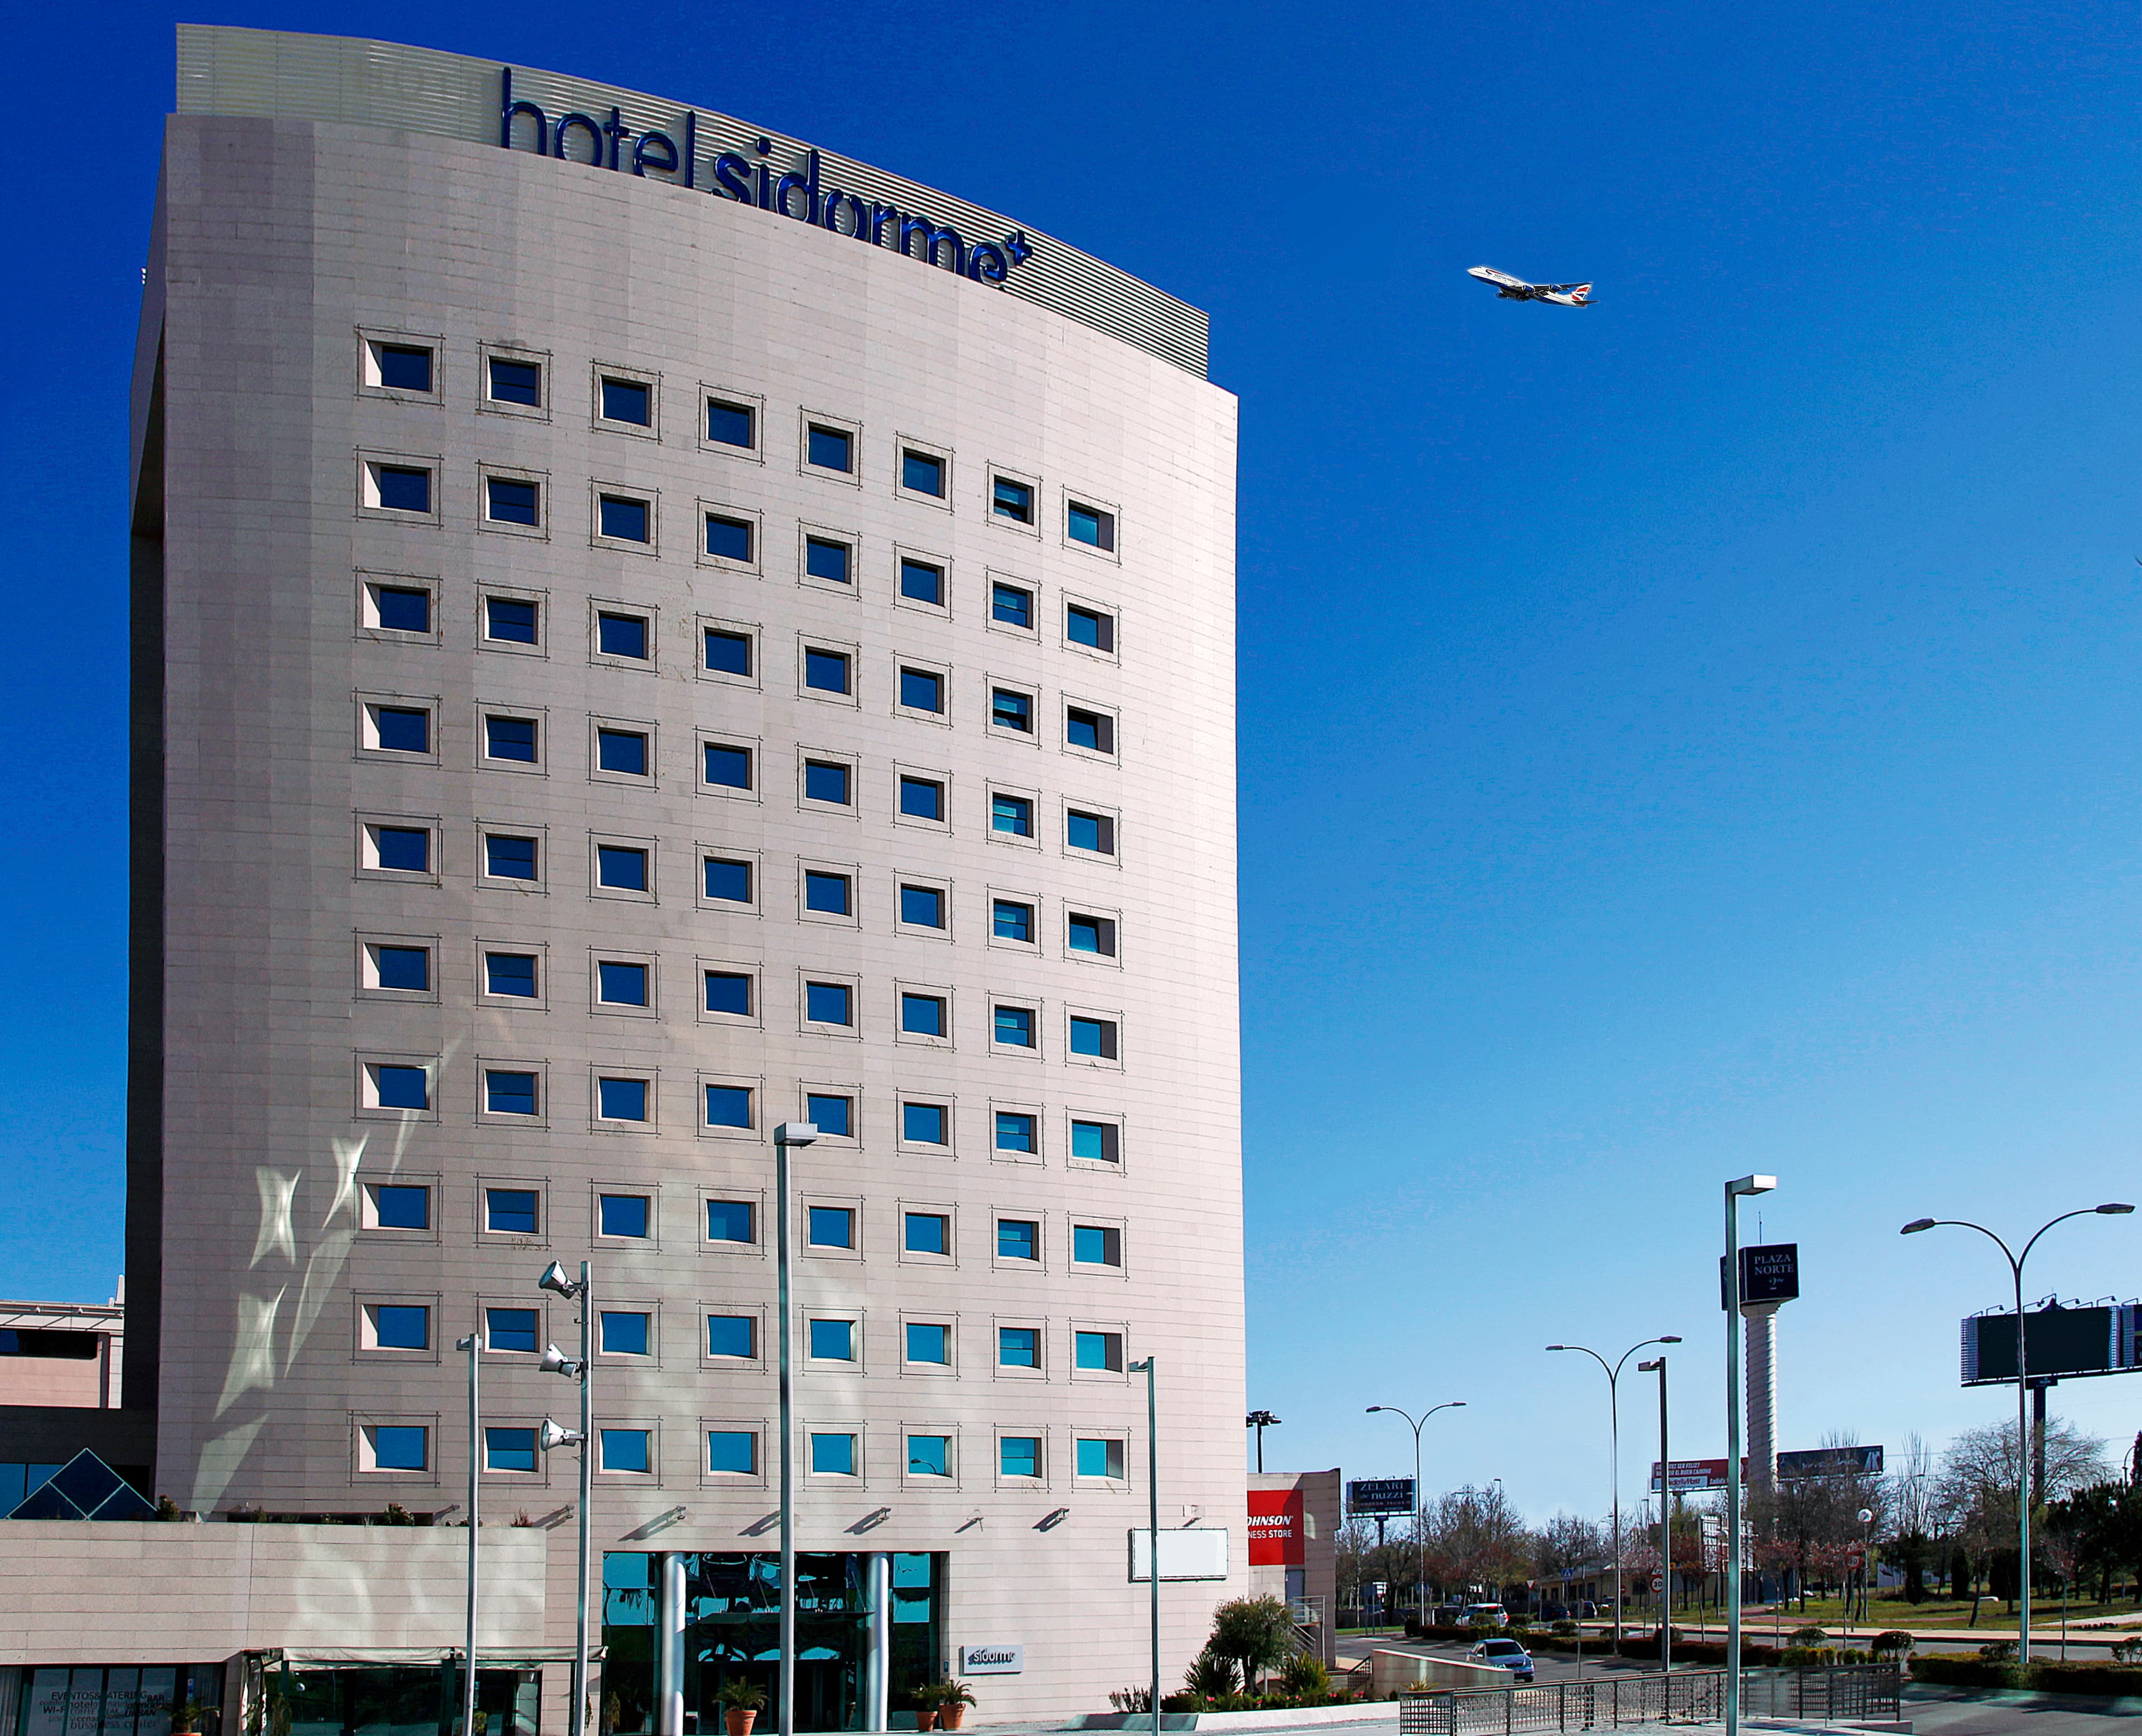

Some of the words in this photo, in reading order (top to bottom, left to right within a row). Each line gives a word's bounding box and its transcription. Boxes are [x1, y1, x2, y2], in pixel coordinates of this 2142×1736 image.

[501, 66, 696, 189] hotel
[1754, 1253, 1791, 1265] PLAZA
[1754, 1264, 1794, 1276] NORTE
[1360, 1482, 1403, 1491] ZELARI
[1371, 1491, 1403, 1500] nuzzi
[1268, 1530, 1292, 1538] STORE
[71, 1719, 122, 1729] bussiess
